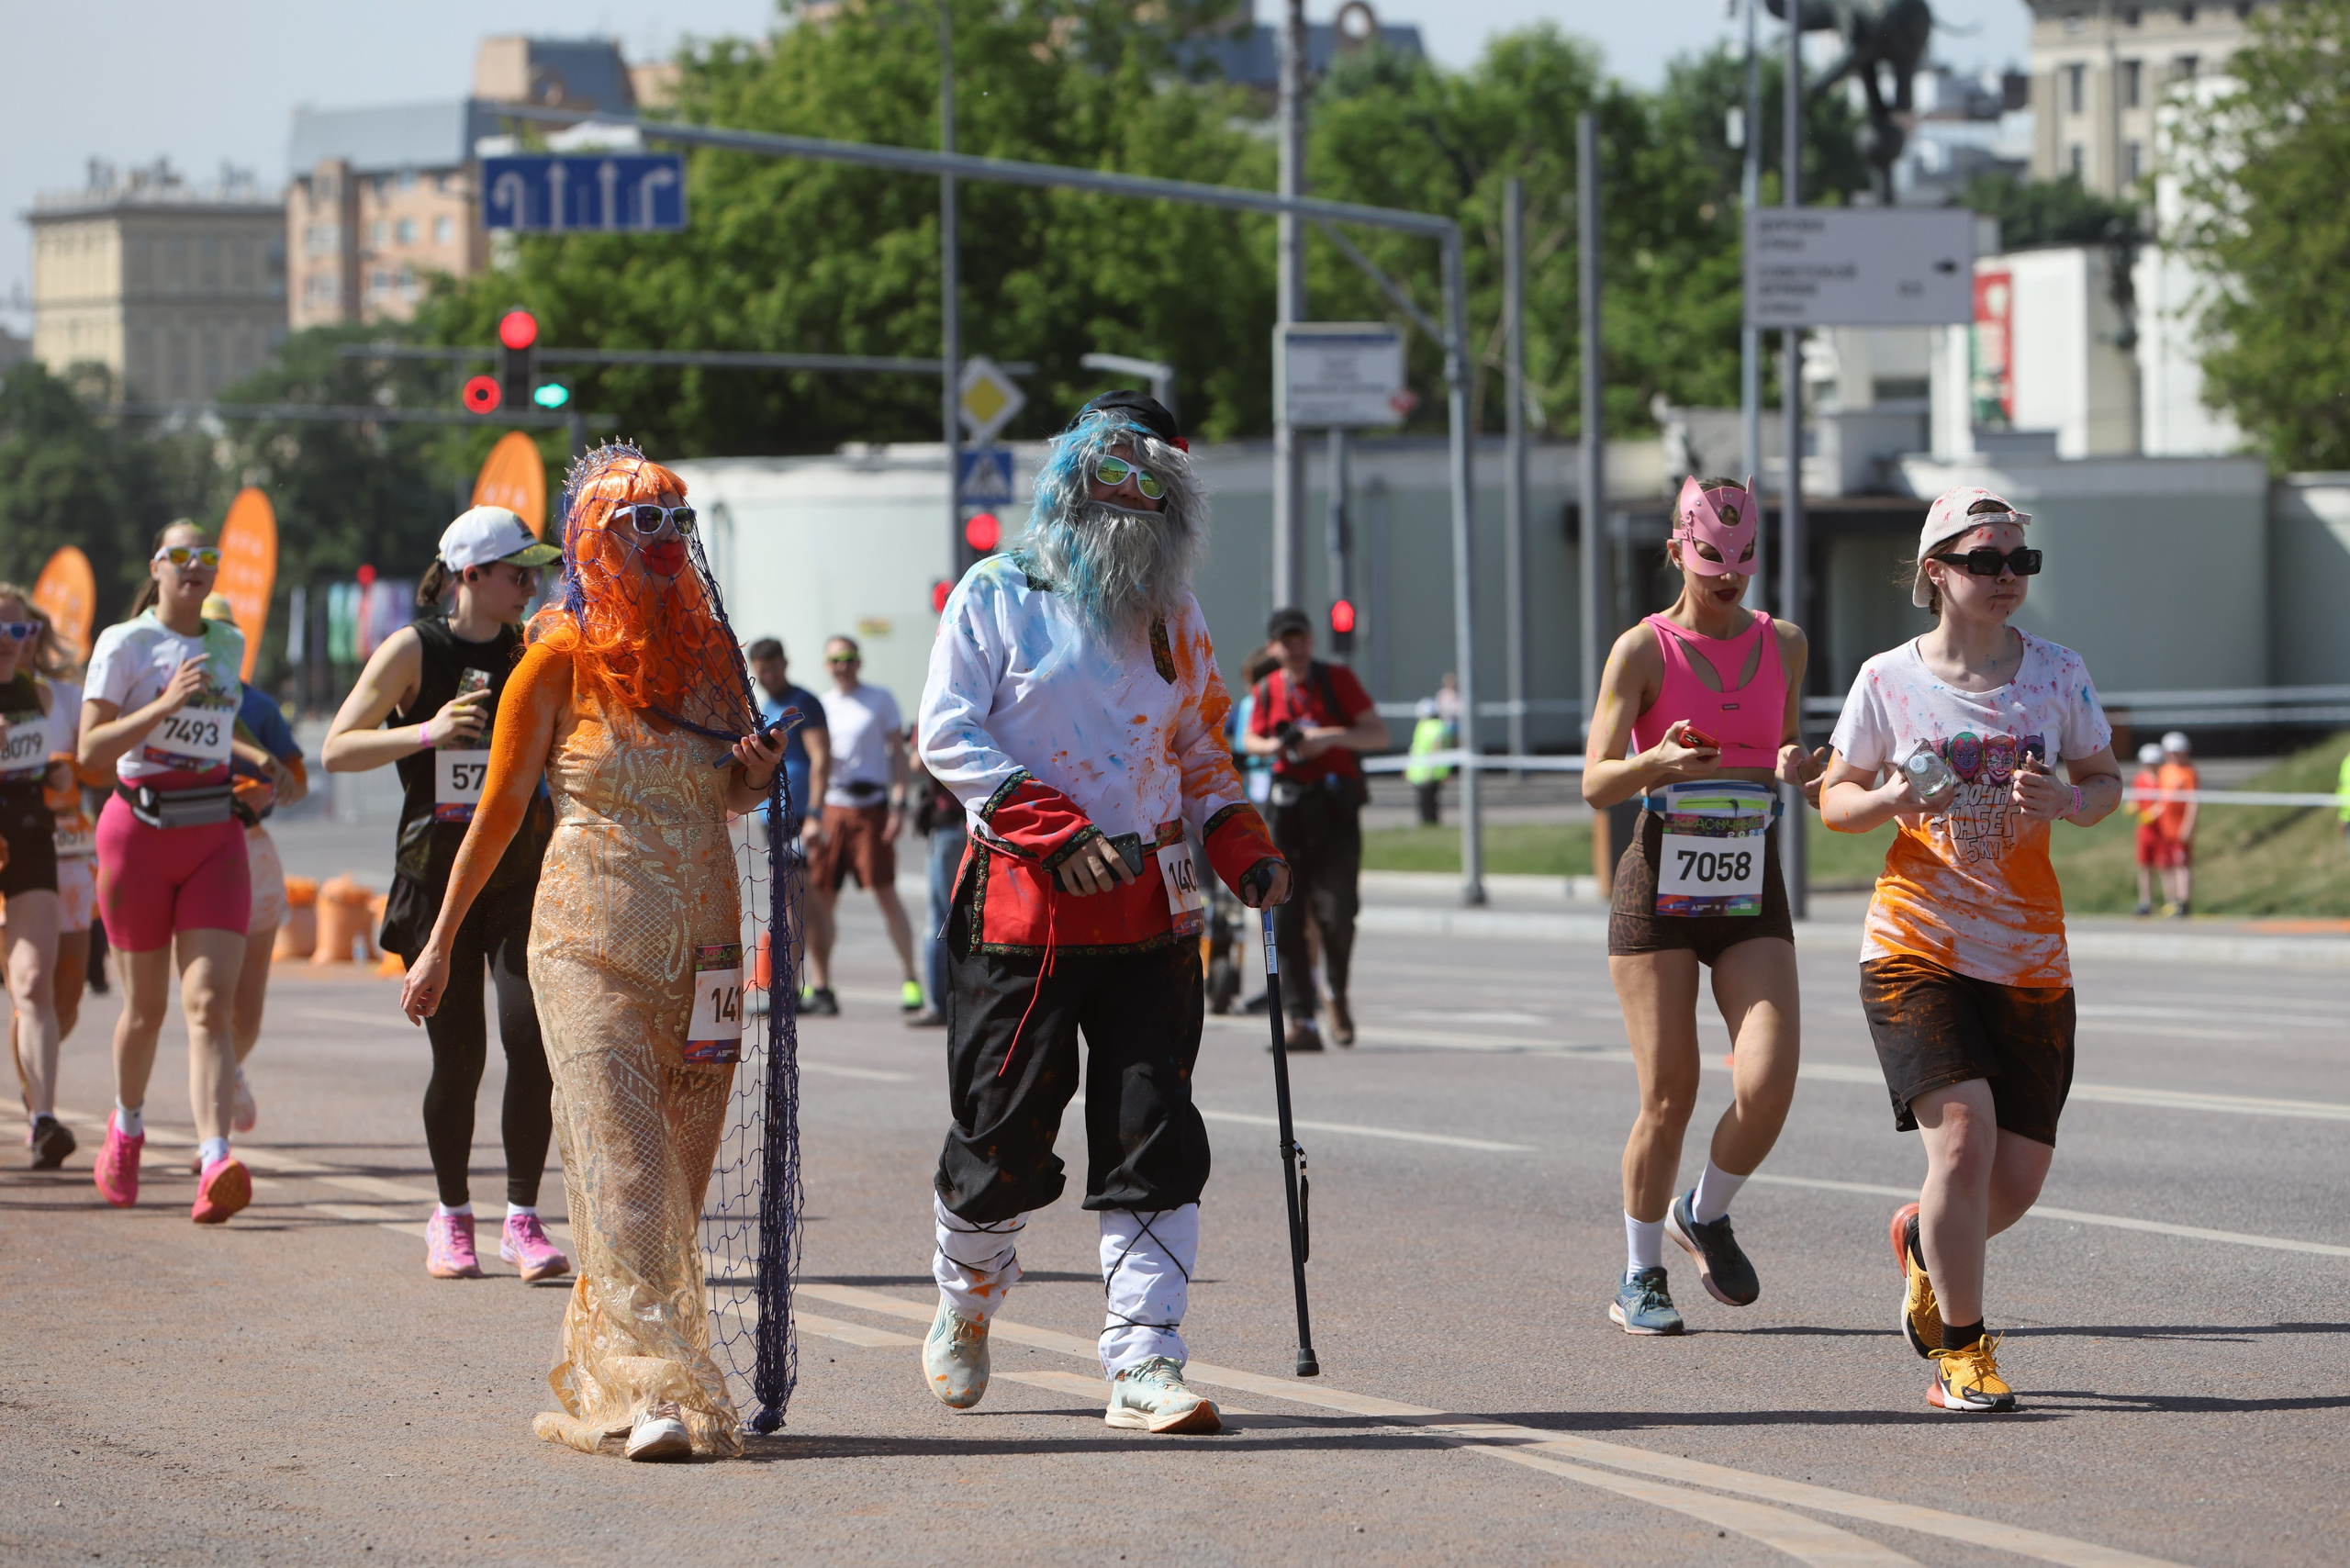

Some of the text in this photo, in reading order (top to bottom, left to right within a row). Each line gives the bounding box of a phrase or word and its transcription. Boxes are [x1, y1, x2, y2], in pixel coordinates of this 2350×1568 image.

[163, 718, 219, 747] 7493
[1169, 858, 1197, 895] 140
[1677, 850, 1751, 882] 7058
[711, 985, 741, 1024] 141
